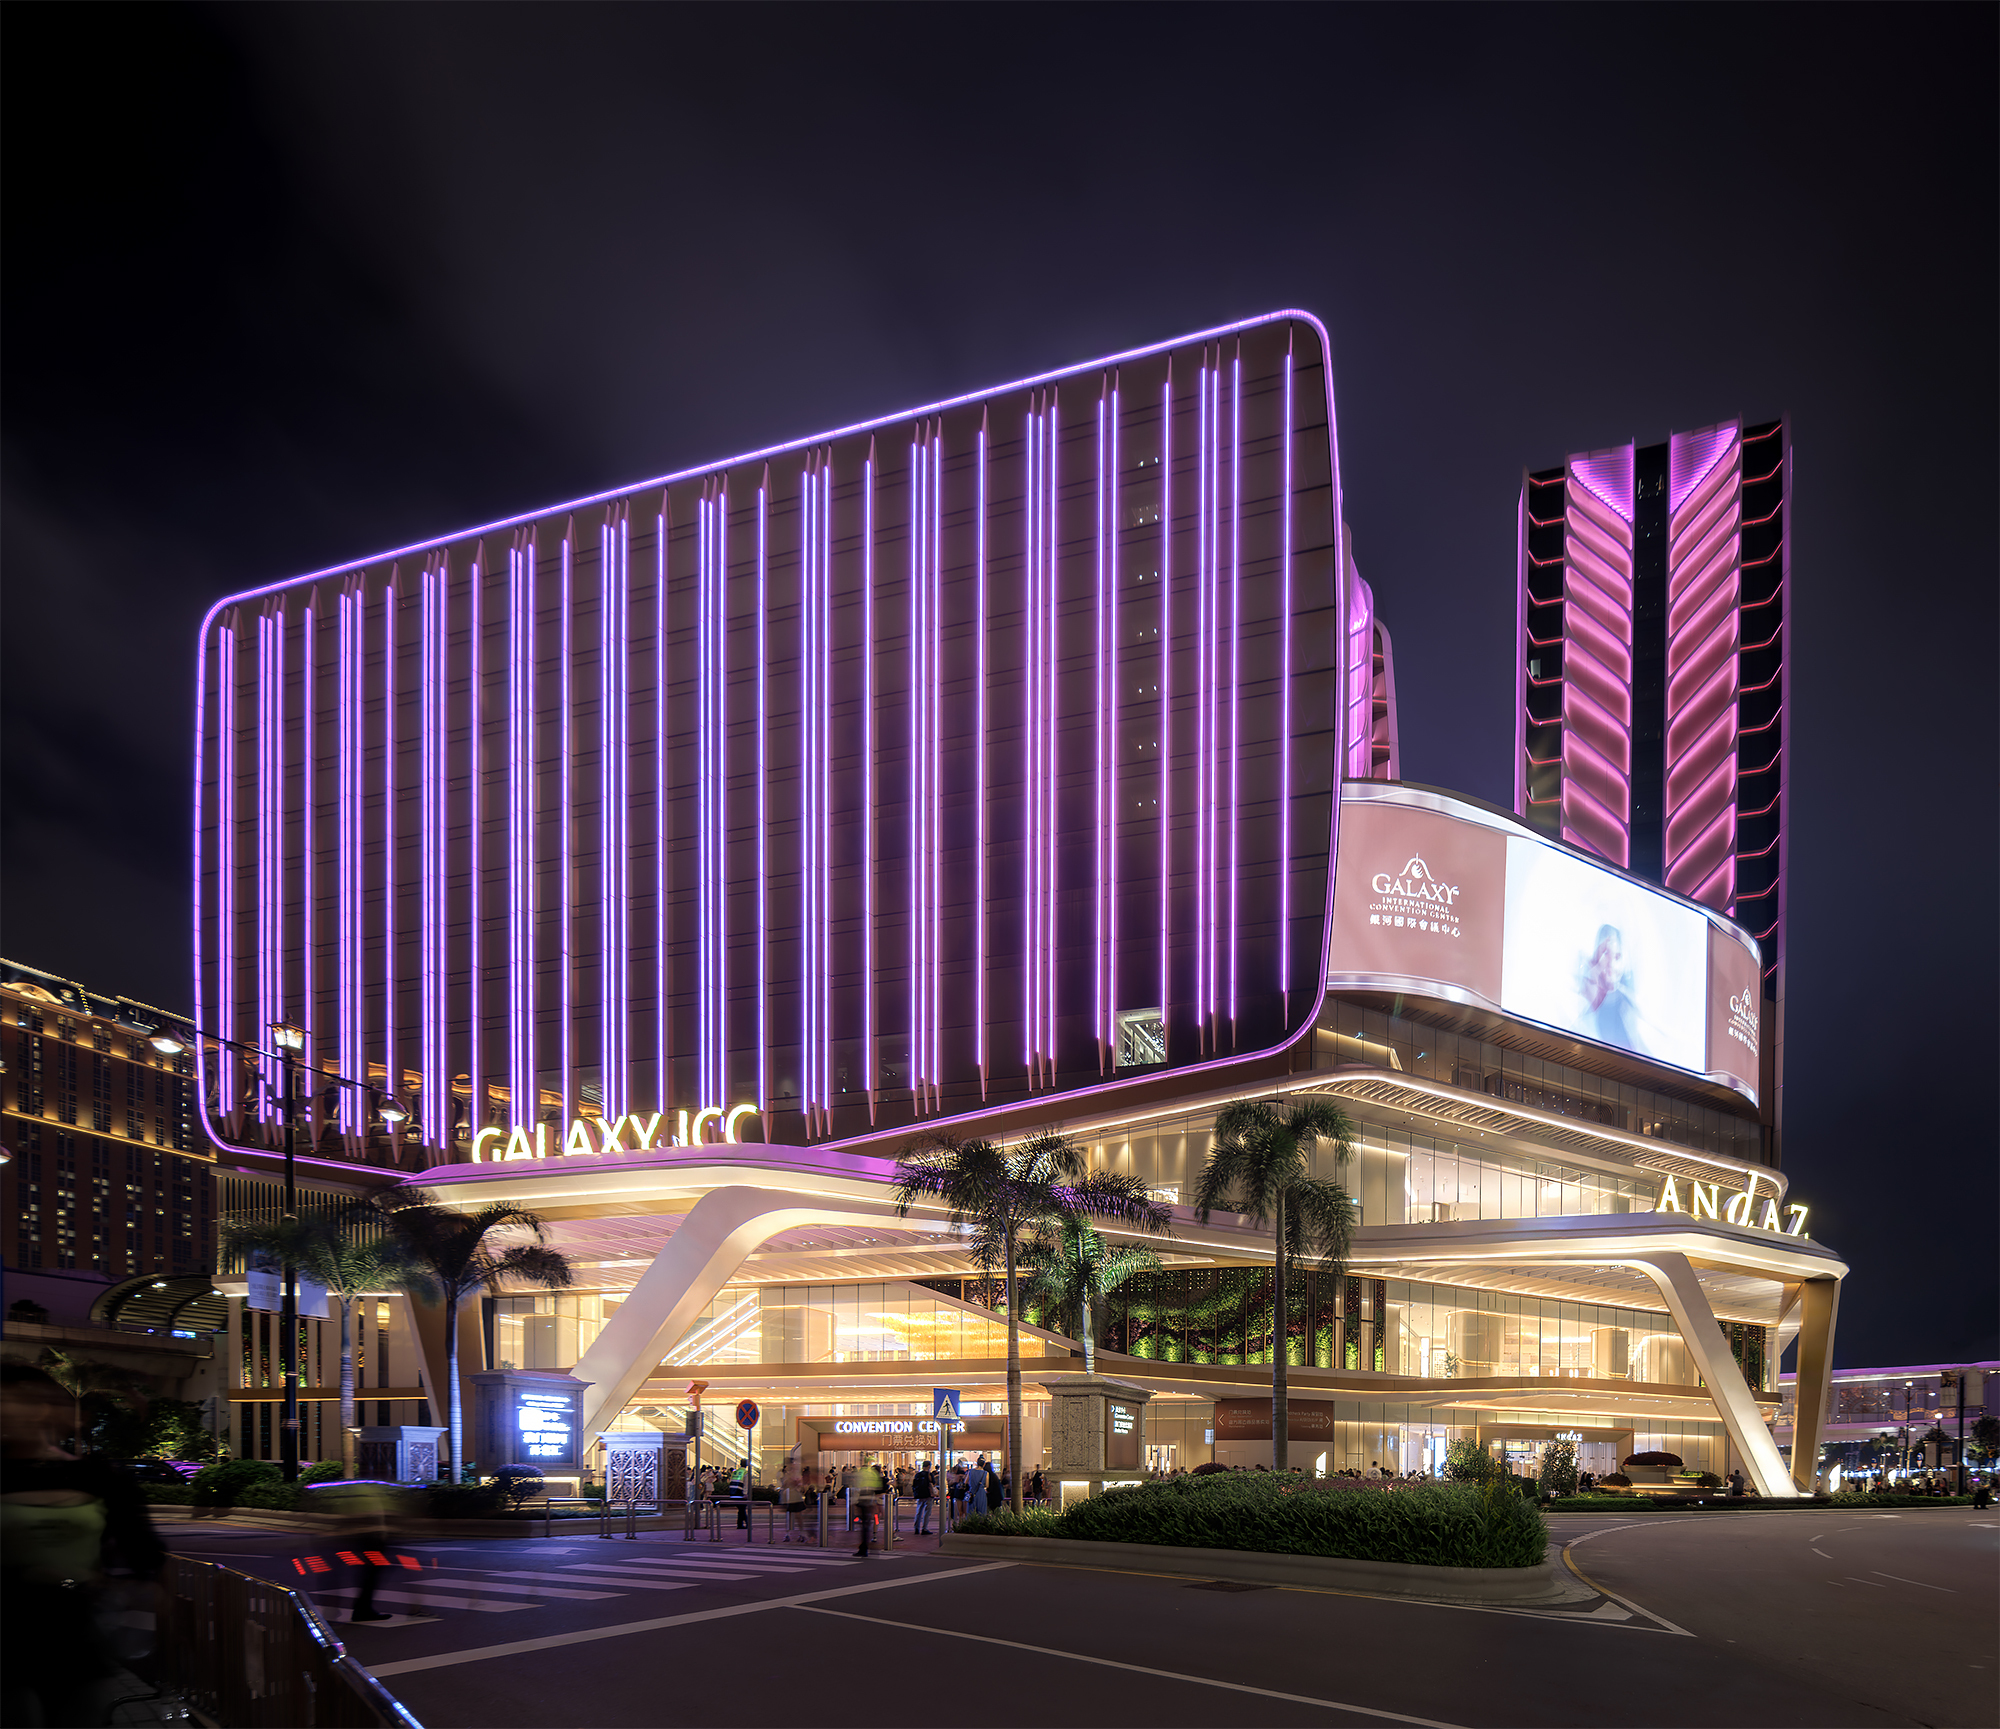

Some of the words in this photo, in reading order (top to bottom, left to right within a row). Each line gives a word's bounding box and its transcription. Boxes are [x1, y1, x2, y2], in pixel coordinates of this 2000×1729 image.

[1371, 873, 1458, 905] GALAXY
[1369, 903, 1427, 916] CONVENTION
[1382, 896, 1450, 914] INTERNATIONAL
[472, 1112, 663, 1164] GALAXY
[678, 1104, 758, 1148] ICC
[835, 1421, 913, 1433] CONVENTION
[918, 1421, 966, 1433] CENER
[882, 1435, 937, 1446] 门票兑换处
